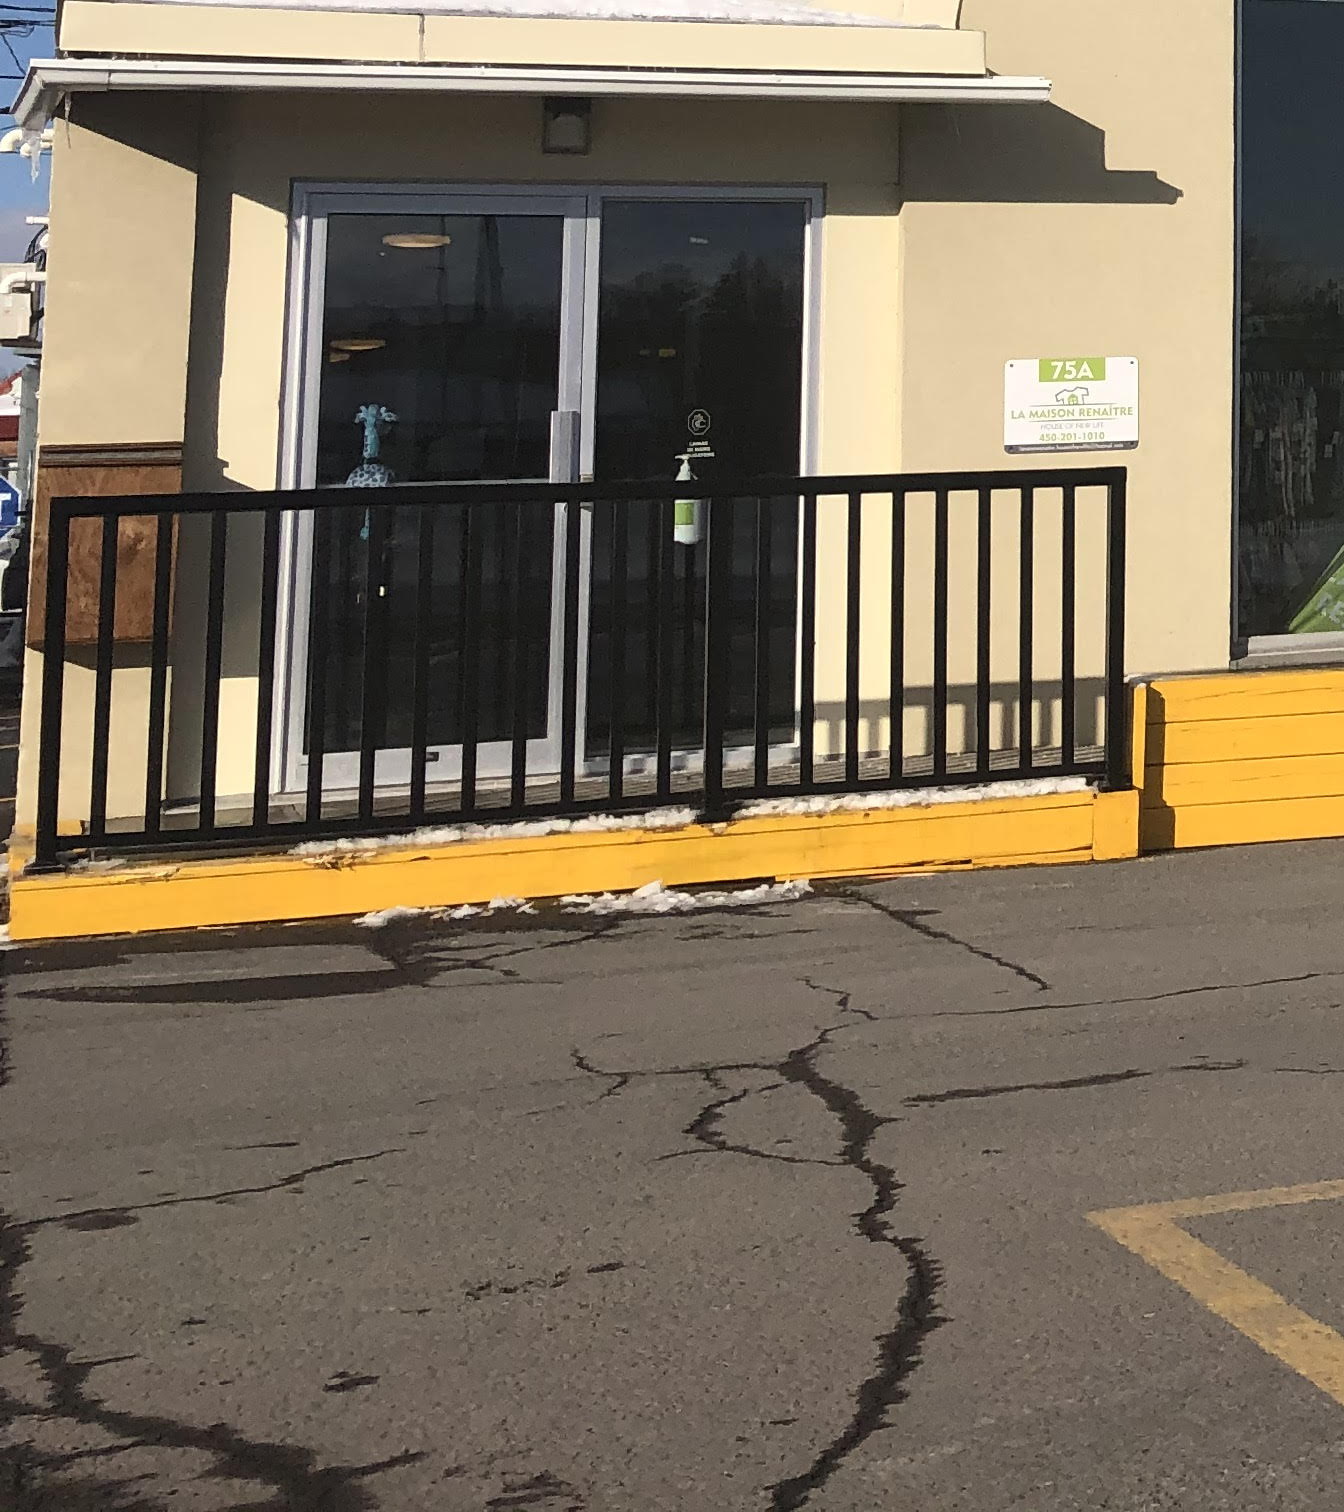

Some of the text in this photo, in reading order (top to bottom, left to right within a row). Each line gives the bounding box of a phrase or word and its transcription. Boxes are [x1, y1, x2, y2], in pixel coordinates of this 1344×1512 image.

[1051, 361, 1094, 380] 75A
[1011, 409, 1026, 420] LA
[1029, 408, 1075, 419] MAISON
